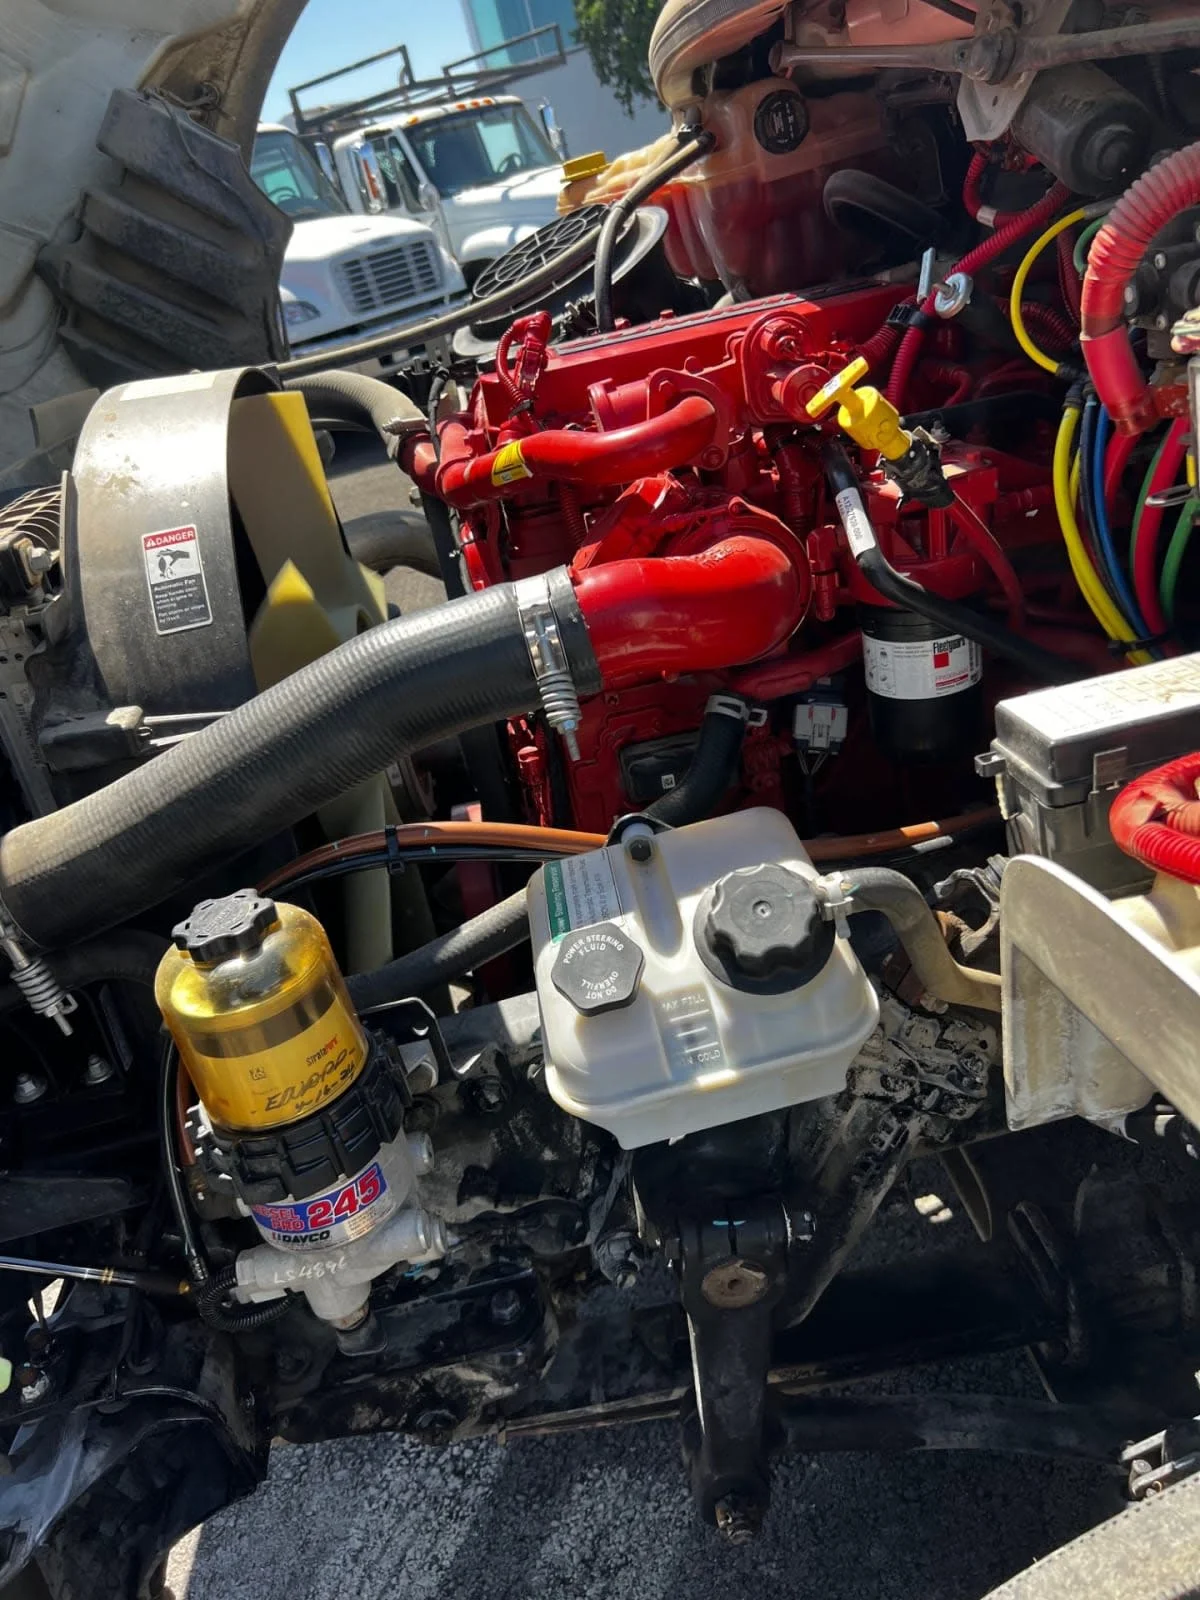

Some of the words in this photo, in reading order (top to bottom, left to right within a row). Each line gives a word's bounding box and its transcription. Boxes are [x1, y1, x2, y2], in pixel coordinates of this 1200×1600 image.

[155, 530, 194, 546] DANGER
[563, 938, 585, 964] POWER
[585, 934, 625, 952] STEERING
[579, 943, 607, 957] FLUID
[581, 970, 619, 991] OVERFILL
[585, 990, 603, 1000] NOT
[605, 985, 618, 996] DO
[697, 1049, 721, 1063] COLD
[306, 1165, 381, 1231] 245
[271, 1218, 304, 1232] PRO
